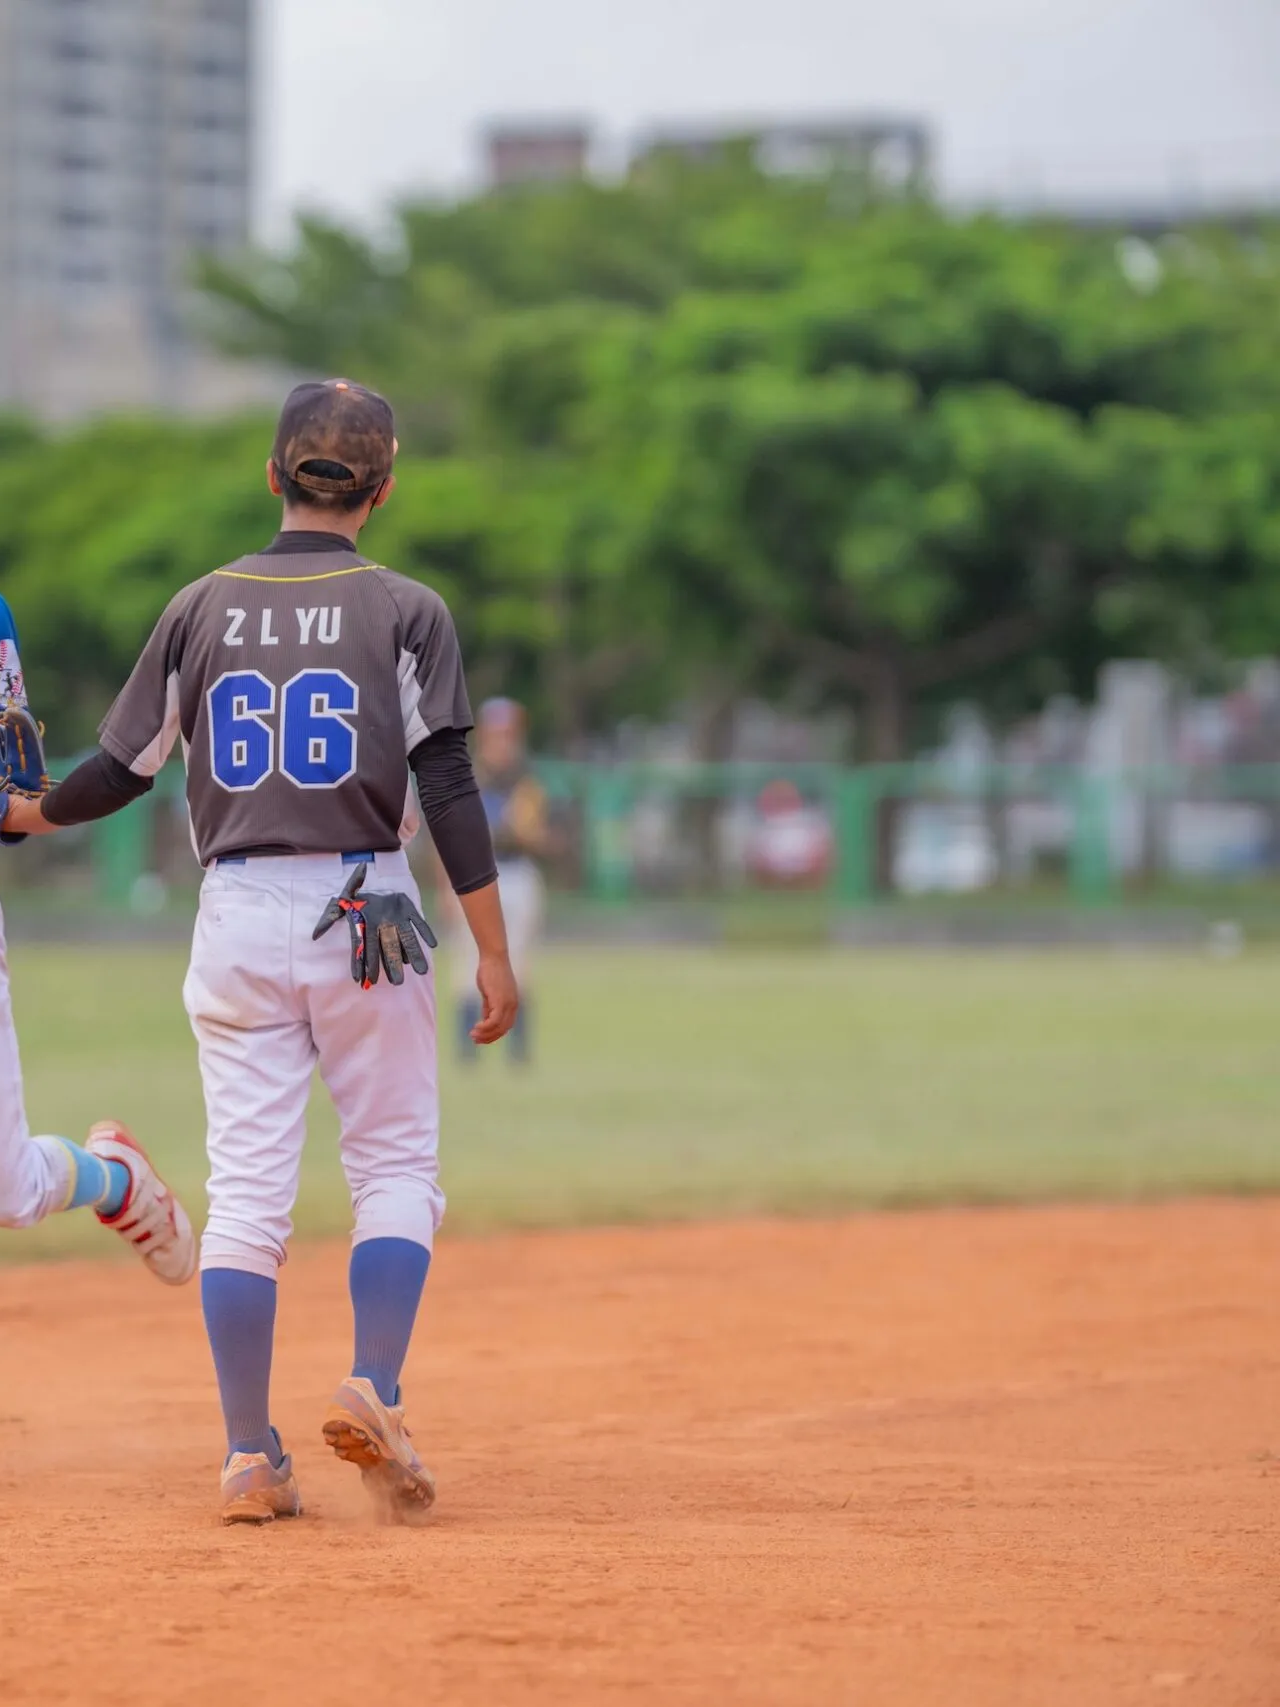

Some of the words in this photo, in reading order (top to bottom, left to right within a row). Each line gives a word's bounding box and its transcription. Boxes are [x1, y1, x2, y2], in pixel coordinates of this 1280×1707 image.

[222, 608, 247, 646] Z
[260, 608, 279, 645] L
[295, 606, 342, 645] YU
[206, 668, 359, 792] 66
